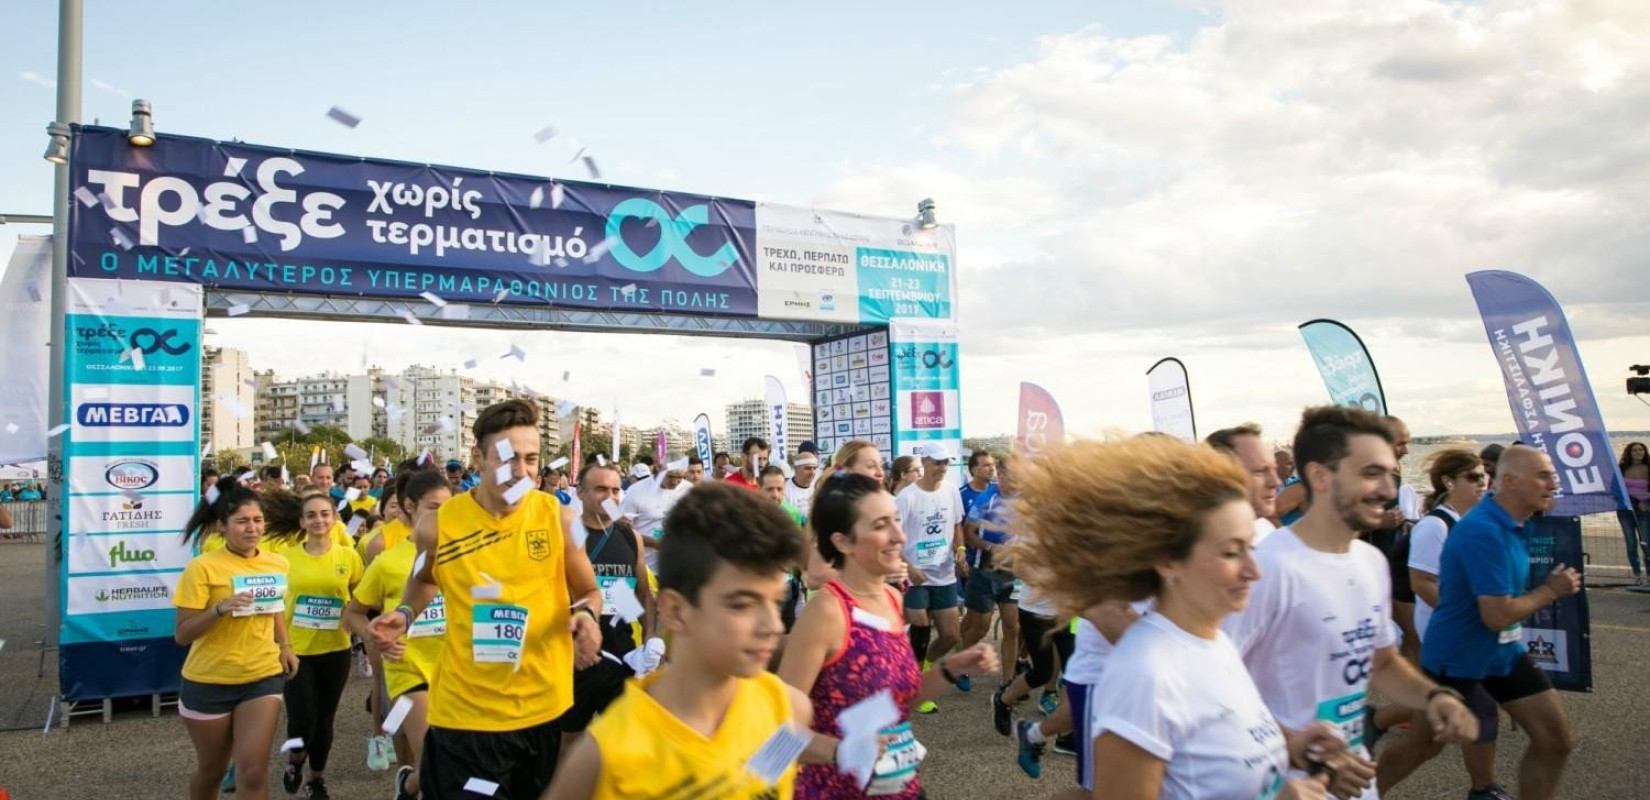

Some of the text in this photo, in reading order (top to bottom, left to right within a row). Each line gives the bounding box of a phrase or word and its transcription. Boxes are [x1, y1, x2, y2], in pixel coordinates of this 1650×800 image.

[87, 157, 346, 251] τρέξε
[366, 177, 483, 219] χωρίς
[365, 219, 587, 260] τερματισμό
[763, 247, 849, 264] ΤΡΕΧΩ, ΠΕΡΠΑΤΩ
[769, 261, 845, 277] ΚΑΙ ΠΡΟΣΦΕΡΩ
[860, 255, 946, 273] ΘΕΣΣΑΛΟΝΙΚΗ
[101, 253, 118, 272] Ο
[137, 254, 353, 286] ΜΕΓΑΛΥΤΕΡΟΣ
[367, 269, 597, 301] ΥΠΕΡΜΑΡΑΘΩΝΙΟΣ
[660, 289, 730, 309] ΠΟΛΗΣ
[891, 277, 920, 290] 21-23
[868, 288, 941, 302] ΣΕΠΤΕΜΒΡΙΟΥ
[895, 304, 920, 316] 2017
[102, 510, 163, 522] ΓΑΤΙΔΗΣ
[117, 520, 149, 529] FRESH
[111, 586, 168, 594] HERBALIFE
[111, 592, 168, 601] NUTRITION
[249, 587, 276, 598] 1806
[306, 606, 331, 617] 1805
[423, 607, 445, 620] 181
[494, 624, 523, 640] 180
